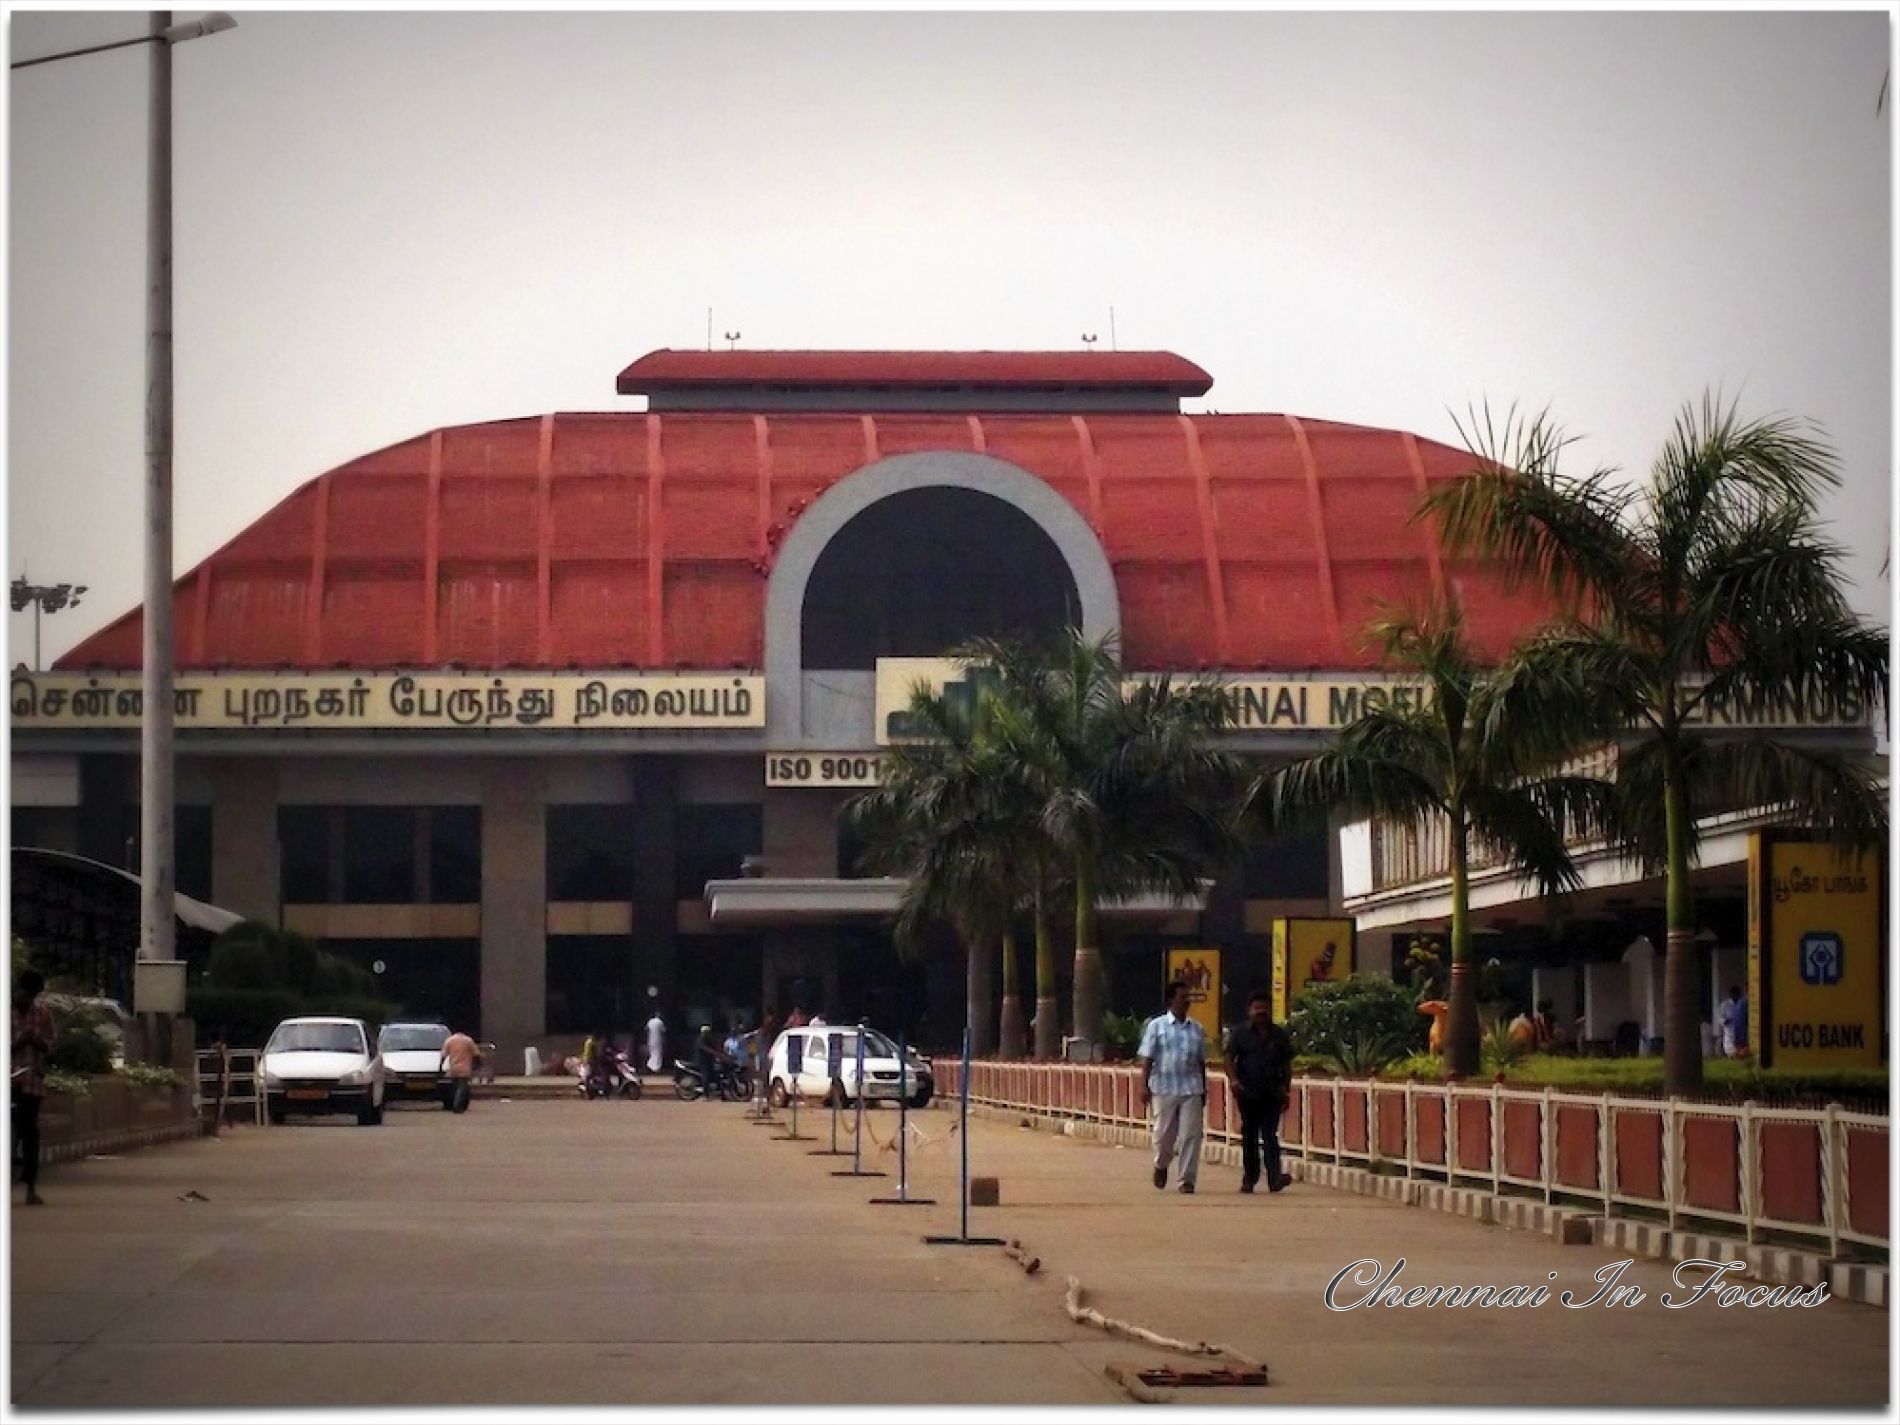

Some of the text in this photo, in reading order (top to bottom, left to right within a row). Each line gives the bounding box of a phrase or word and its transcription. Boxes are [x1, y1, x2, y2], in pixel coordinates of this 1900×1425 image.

[224, 678, 371, 725] புறநகர்
[389, 677, 553, 725] பேருந்து
[573, 678, 752, 725] நிலையம்
[770, 757, 812, 780] ISO
[1778, 1023, 1865, 1049] UCO BANK
